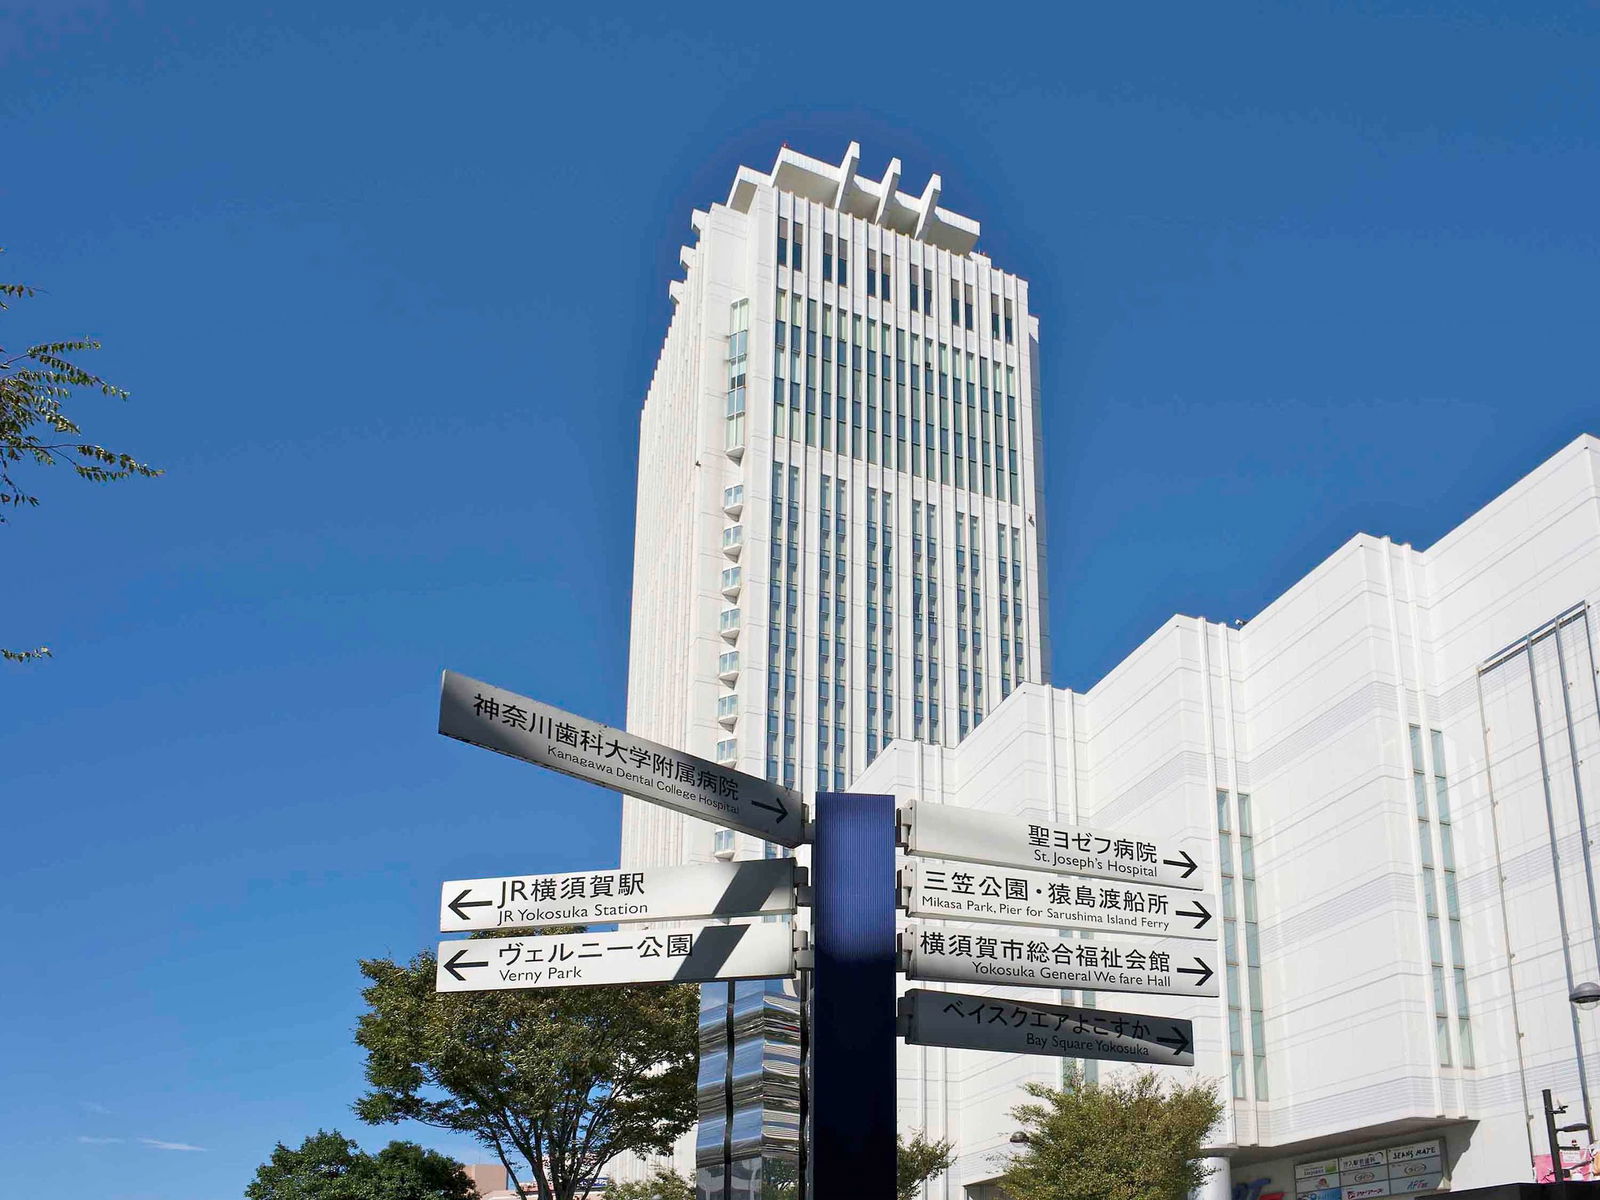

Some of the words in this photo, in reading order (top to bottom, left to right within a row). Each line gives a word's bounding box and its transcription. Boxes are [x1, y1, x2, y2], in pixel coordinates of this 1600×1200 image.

[473, 693, 739, 801] 神奈川歯科大学附属病院
[547, 745, 614, 775] Kanagawa
[616, 767, 654, 788] Dental
[656, 780, 697, 802] College
[698, 794, 740, 814] Hospital
[1028, 824, 1158, 864] 聖ヨゼフ病院
[1034, 849, 1050, 863] St.
[1052, 851, 1104, 870] Joseph's
[1107, 860, 1158, 878] Hospital
[497, 872, 645, 910] JR横須賀駅
[924, 871, 1169, 915] 三笠公園・猿島渡船所
[497, 910, 514, 926] JR
[518, 905, 589, 922] Yokosuka
[594, 902, 648, 917] Station
[921, 897, 962, 911] Mikasa
[966, 900, 997, 914] Park,
[999, 903, 1023, 916] Pier
[1026, 905, 1043, 918] for
[1047, 908, 1103, 924] Sarushima
[1106, 914, 1138, 927] Island
[1141, 917, 1170, 932] Ferry
[498, 933, 694, 967] ヴェルニー公園
[920, 931, 1170, 973] 横須賀市総合福祉会館
[499, 970, 542, 985] Verny
[547, 966, 582, 980] Park
[972, 961, 1035, 979] Yokosuka
[1040, 966, 1091, 982] General
[1147, 974, 1171, 988] Hall
[943, 1000, 1150, 1040] ベイスクエアよこすか
[1026, 1032, 1048, 1049] Bay
[1052, 1036, 1094, 1052] Square
[1095, 1039, 1149, 1057] Yokosuka
